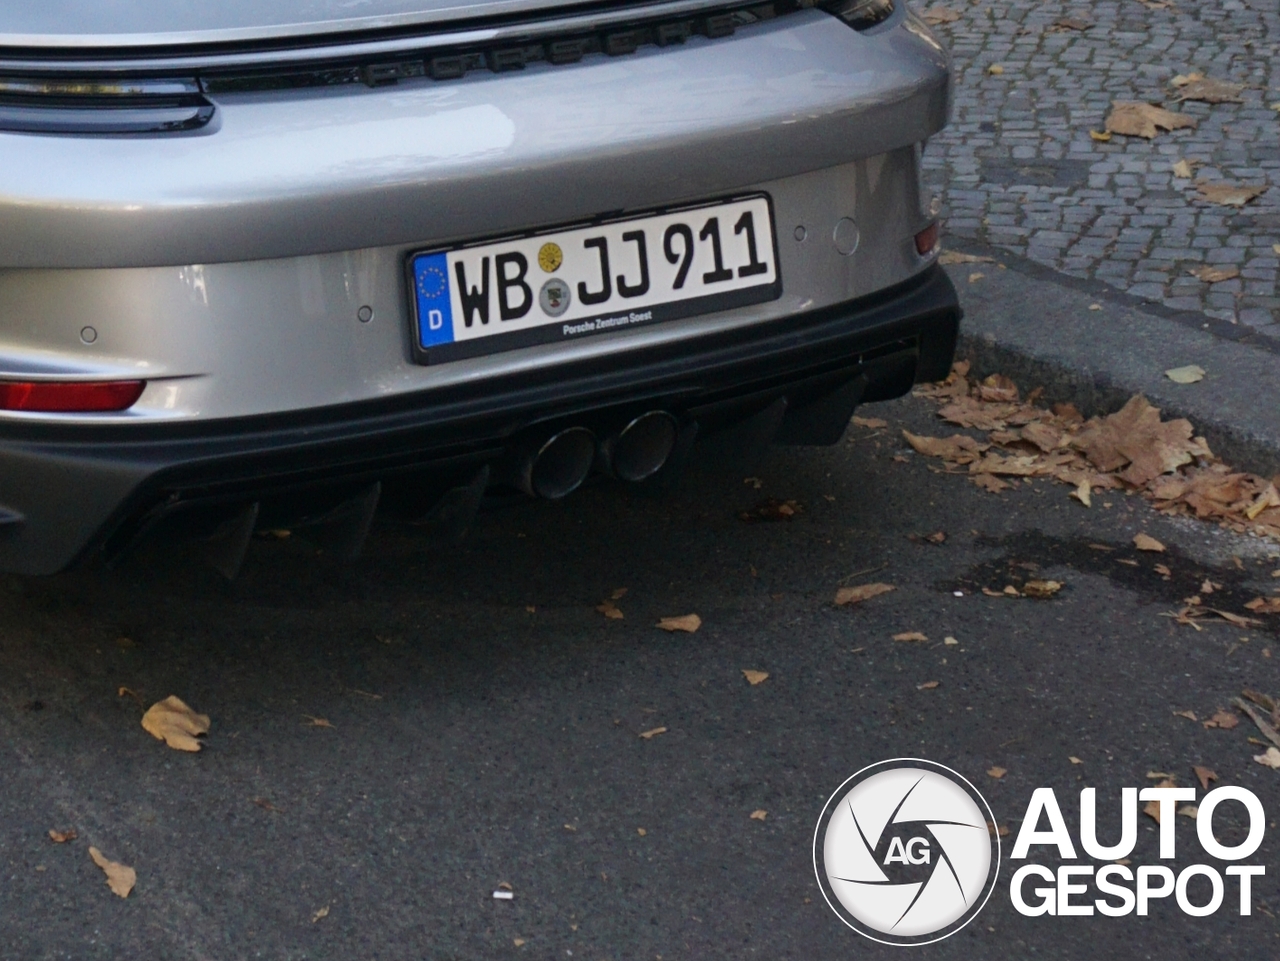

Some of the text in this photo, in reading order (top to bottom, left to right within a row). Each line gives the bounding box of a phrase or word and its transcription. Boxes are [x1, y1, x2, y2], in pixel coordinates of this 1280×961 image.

[454, 211, 768, 328] WB JJ 911
[428, 309, 443, 330] D
[562, 311, 652, 336] Porsche Zentrum Soest
